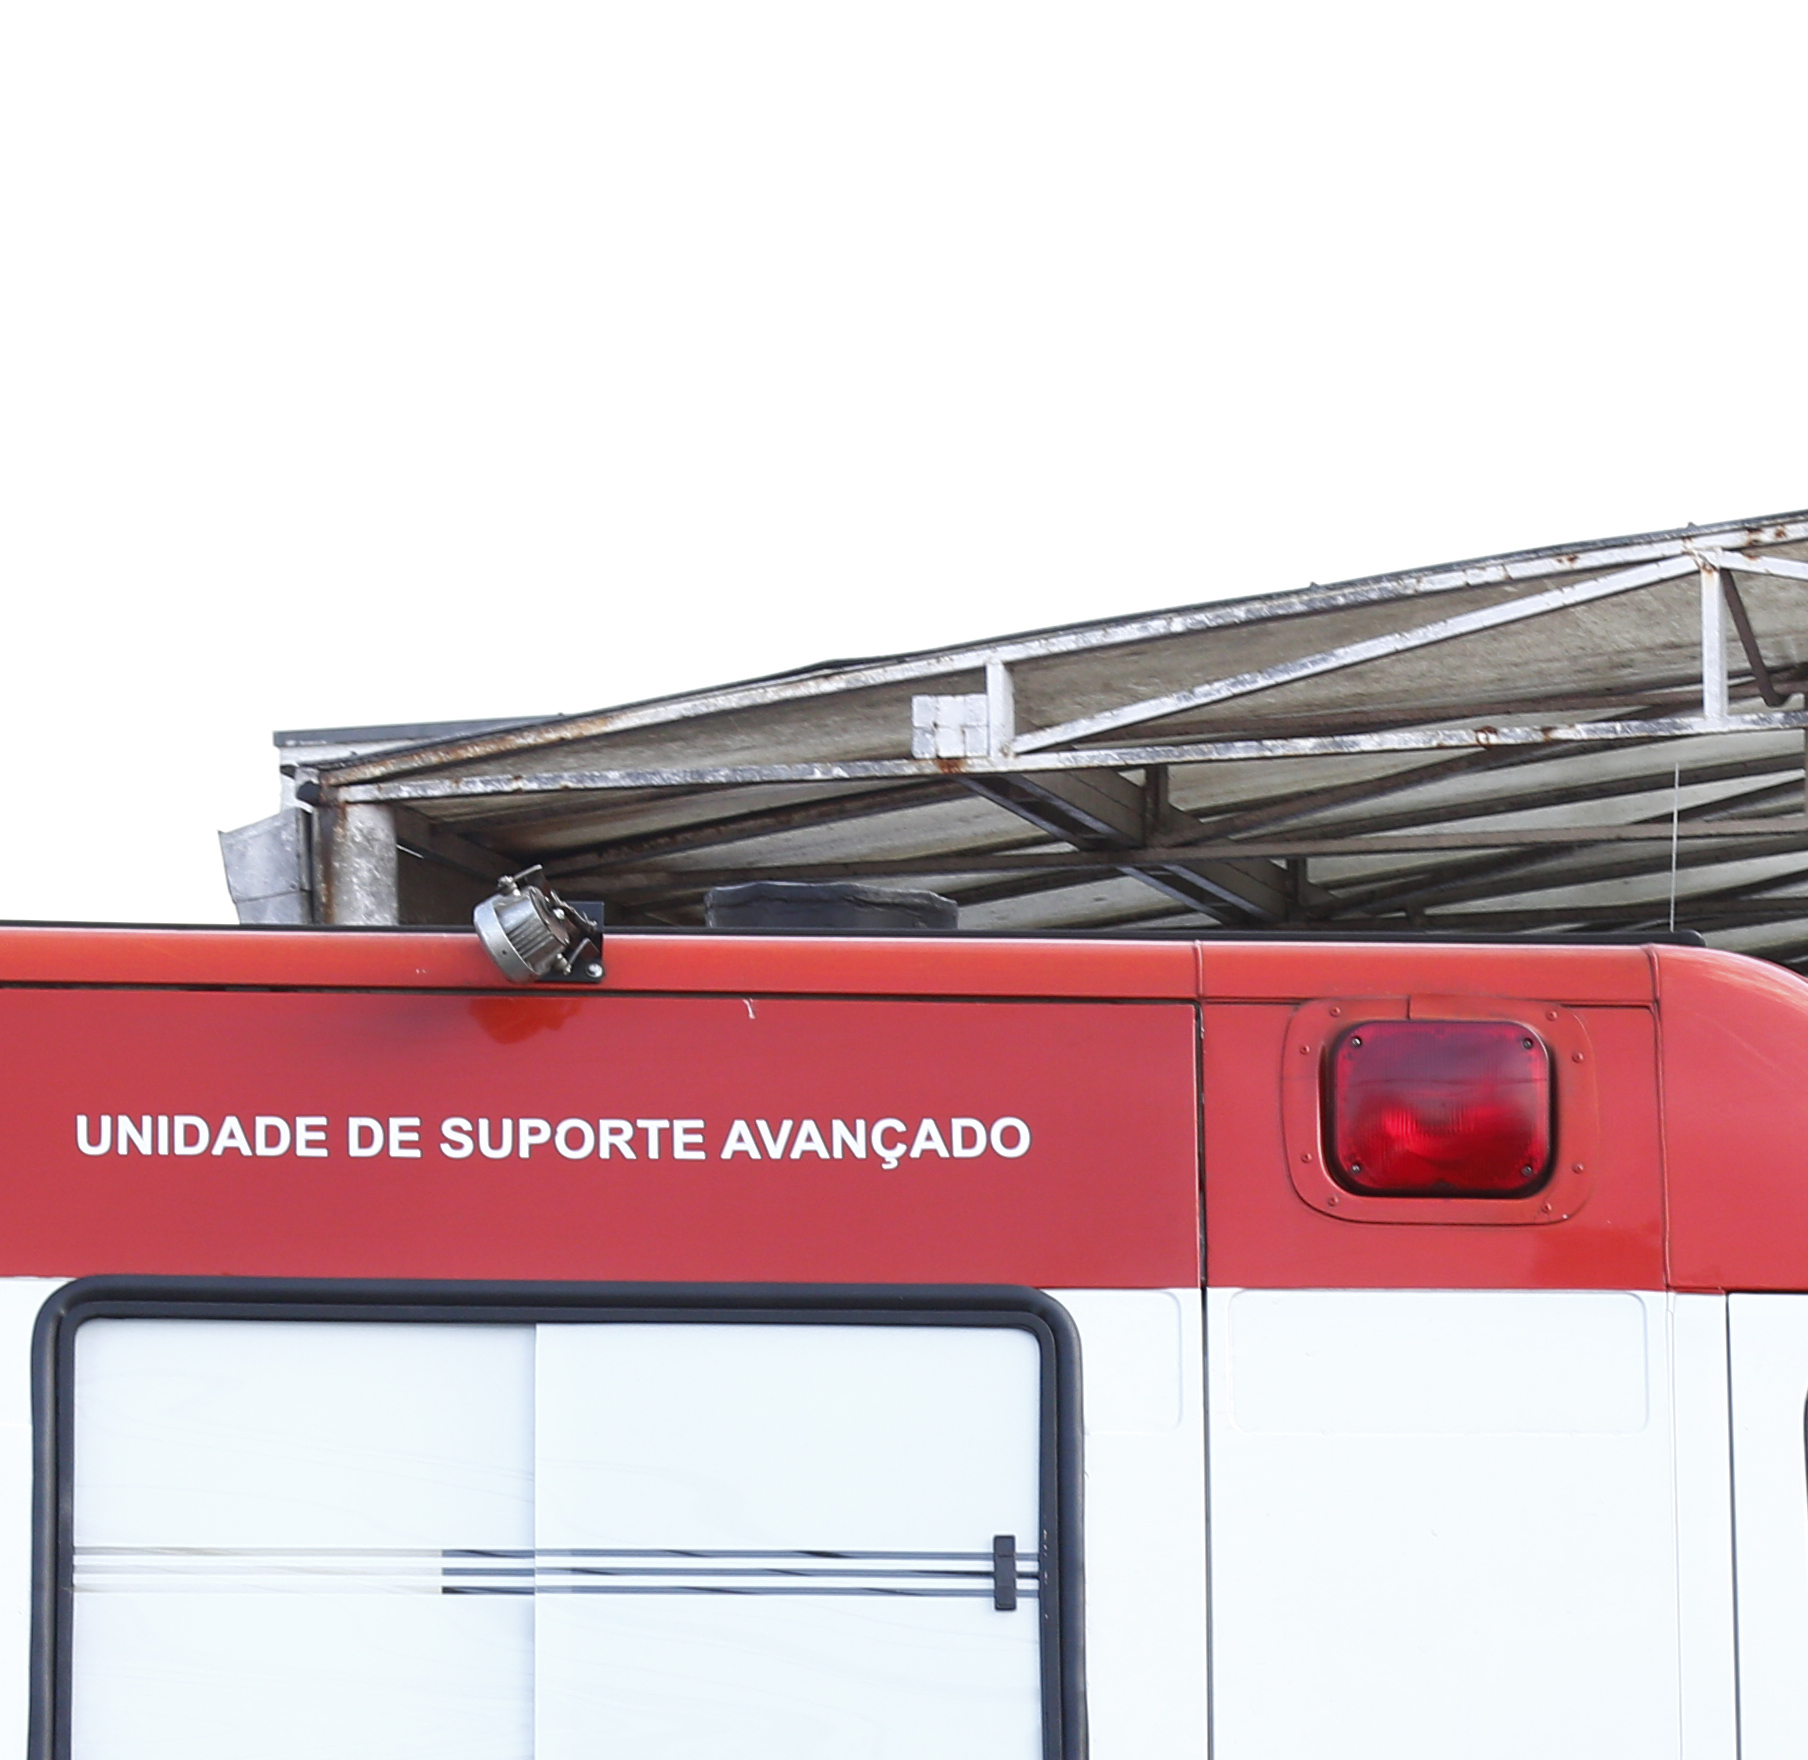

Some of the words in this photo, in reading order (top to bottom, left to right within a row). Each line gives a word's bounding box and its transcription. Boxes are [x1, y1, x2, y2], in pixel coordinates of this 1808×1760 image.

[75, 1114, 329, 1158] UNIDADE
[348, 1116, 422, 1158] DE
[439, 1117, 706, 1160] SUPORTE
[720, 1116, 1031, 1170] AVANÇADO
